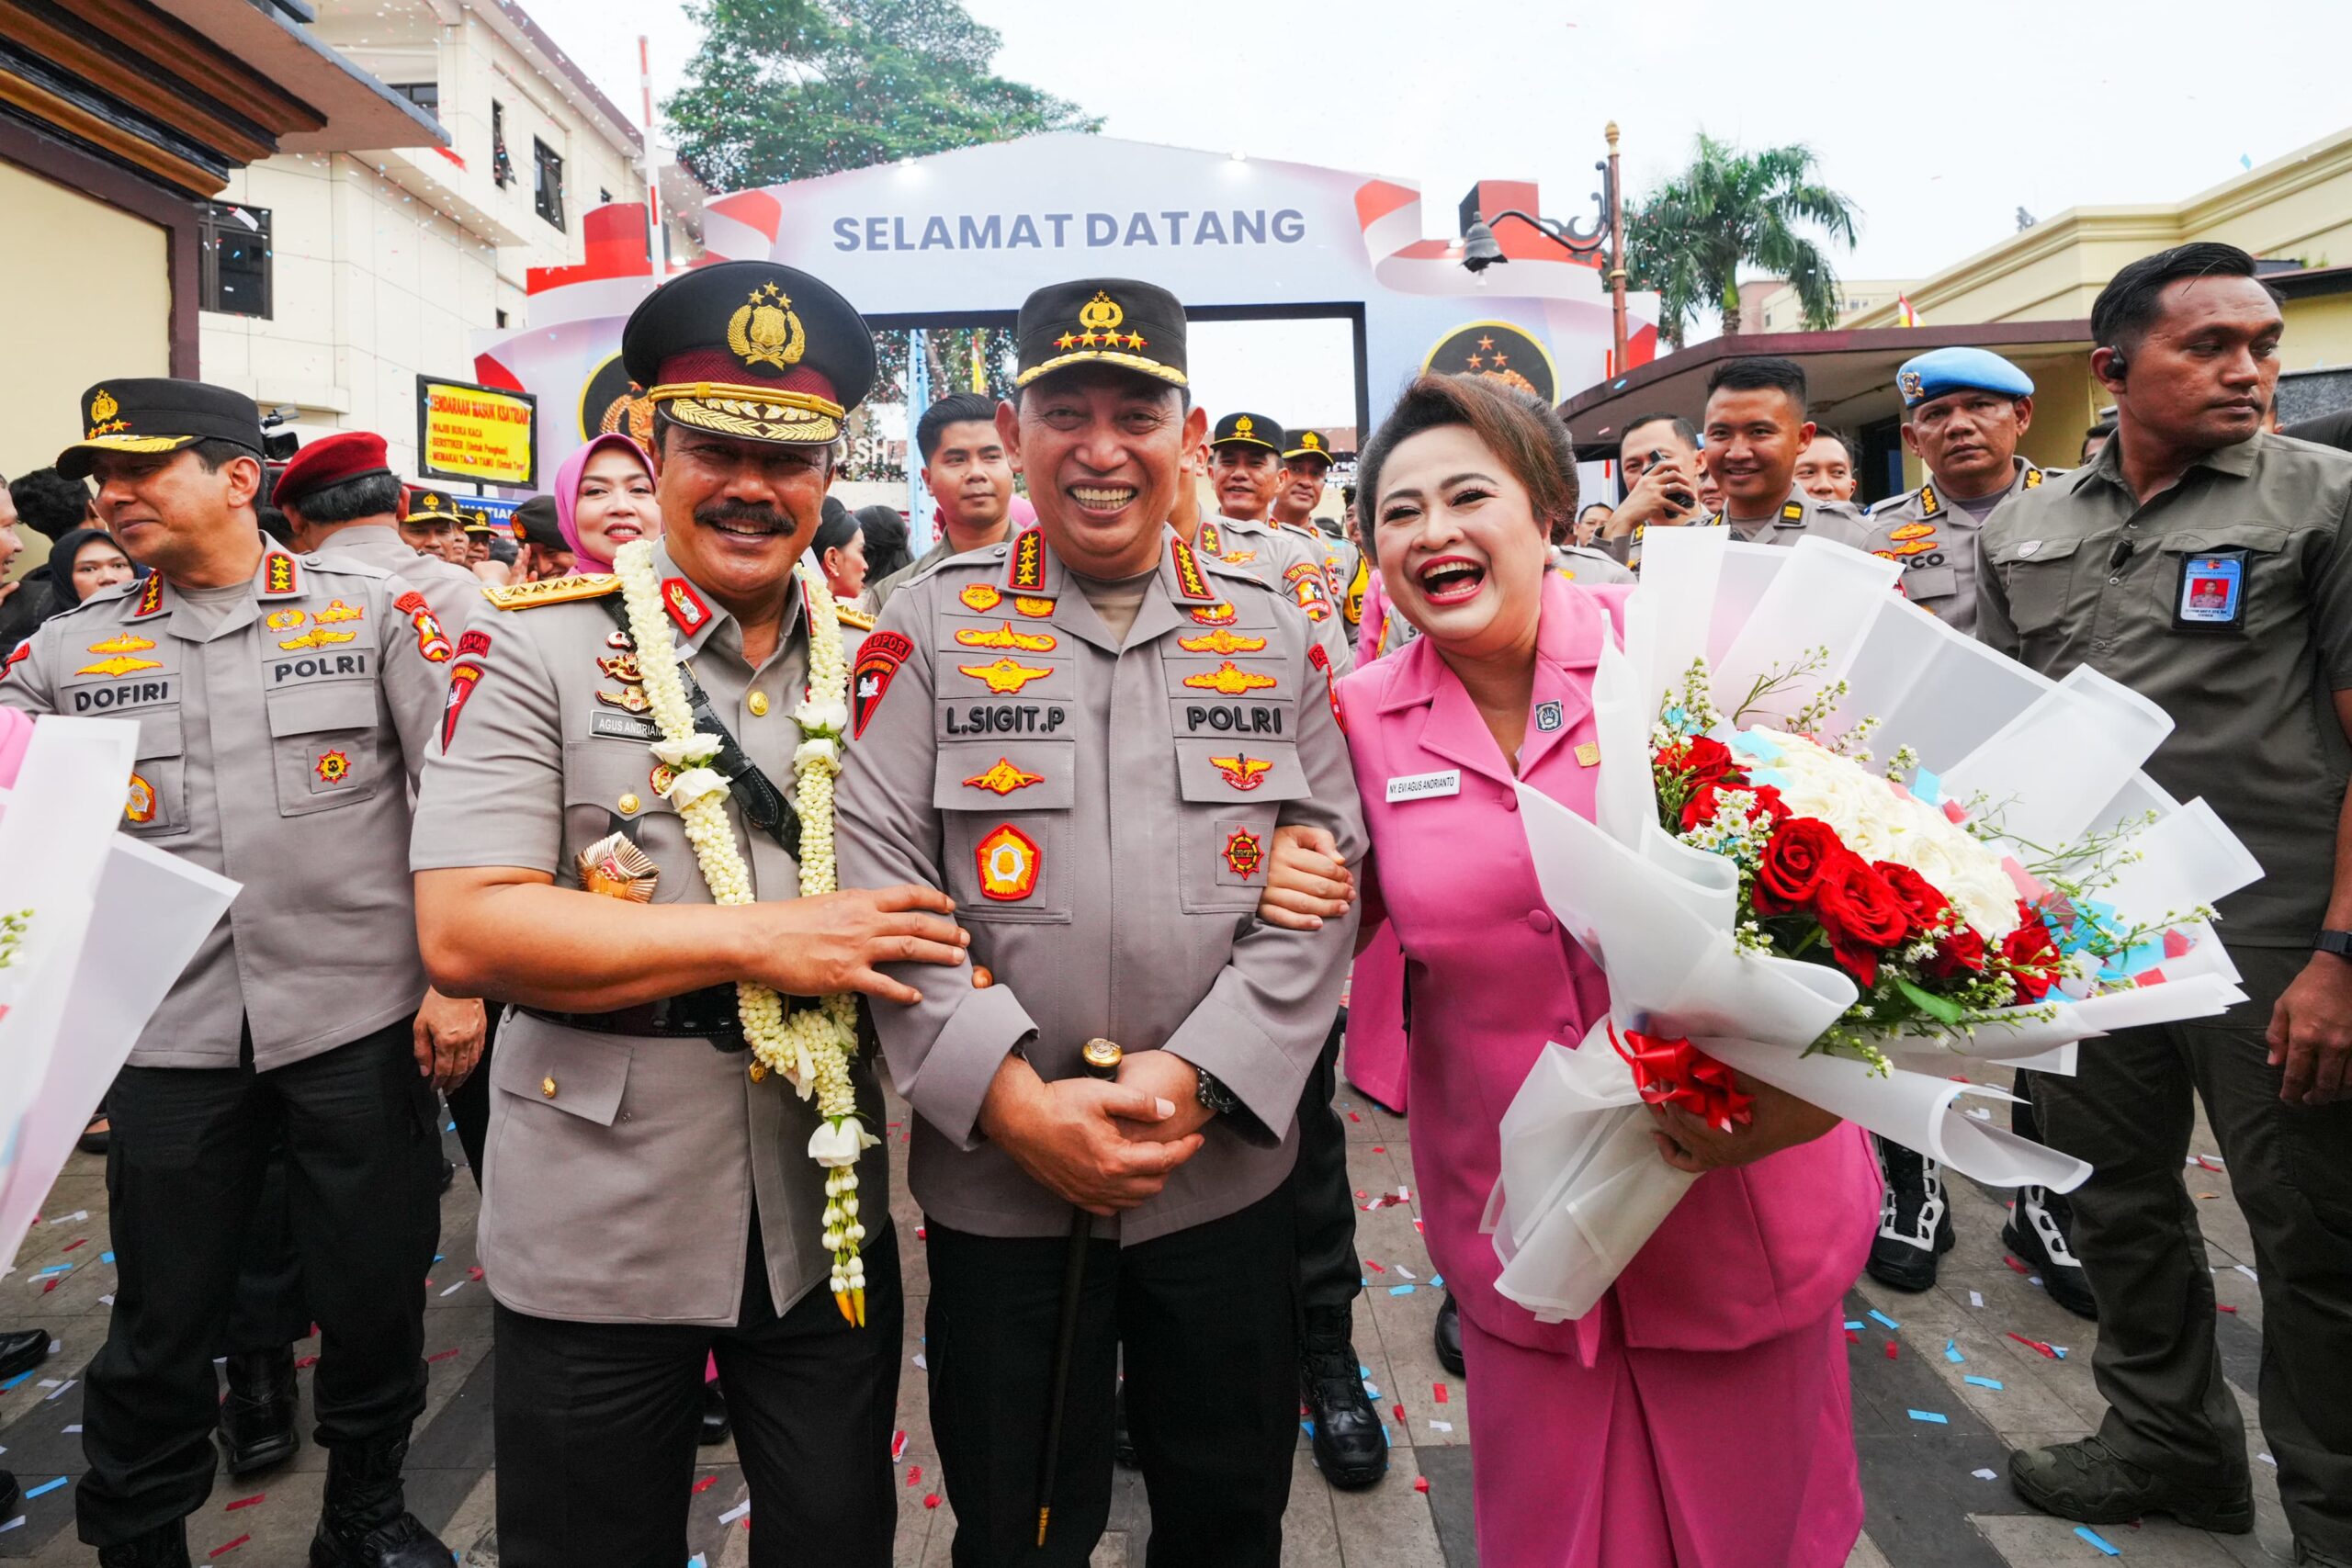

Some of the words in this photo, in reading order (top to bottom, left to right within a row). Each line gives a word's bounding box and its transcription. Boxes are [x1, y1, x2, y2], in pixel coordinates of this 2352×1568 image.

[832, 213, 1074, 253] SELAMAT
[1085, 209, 1306, 247] DATANG
[275, 655, 366, 682] POLRI
[74, 682, 169, 712] DOFIRI
[598, 718, 623, 732] AGUS
[624, 722, 662, 737] ANDRIAN
[946, 705, 1066, 734] L.SIGIT.P
[1186, 705, 1282, 735] POLRI
[1408, 780, 1422, 791] AGUS
[1423, 776, 1455, 790] ANDRIANTO
